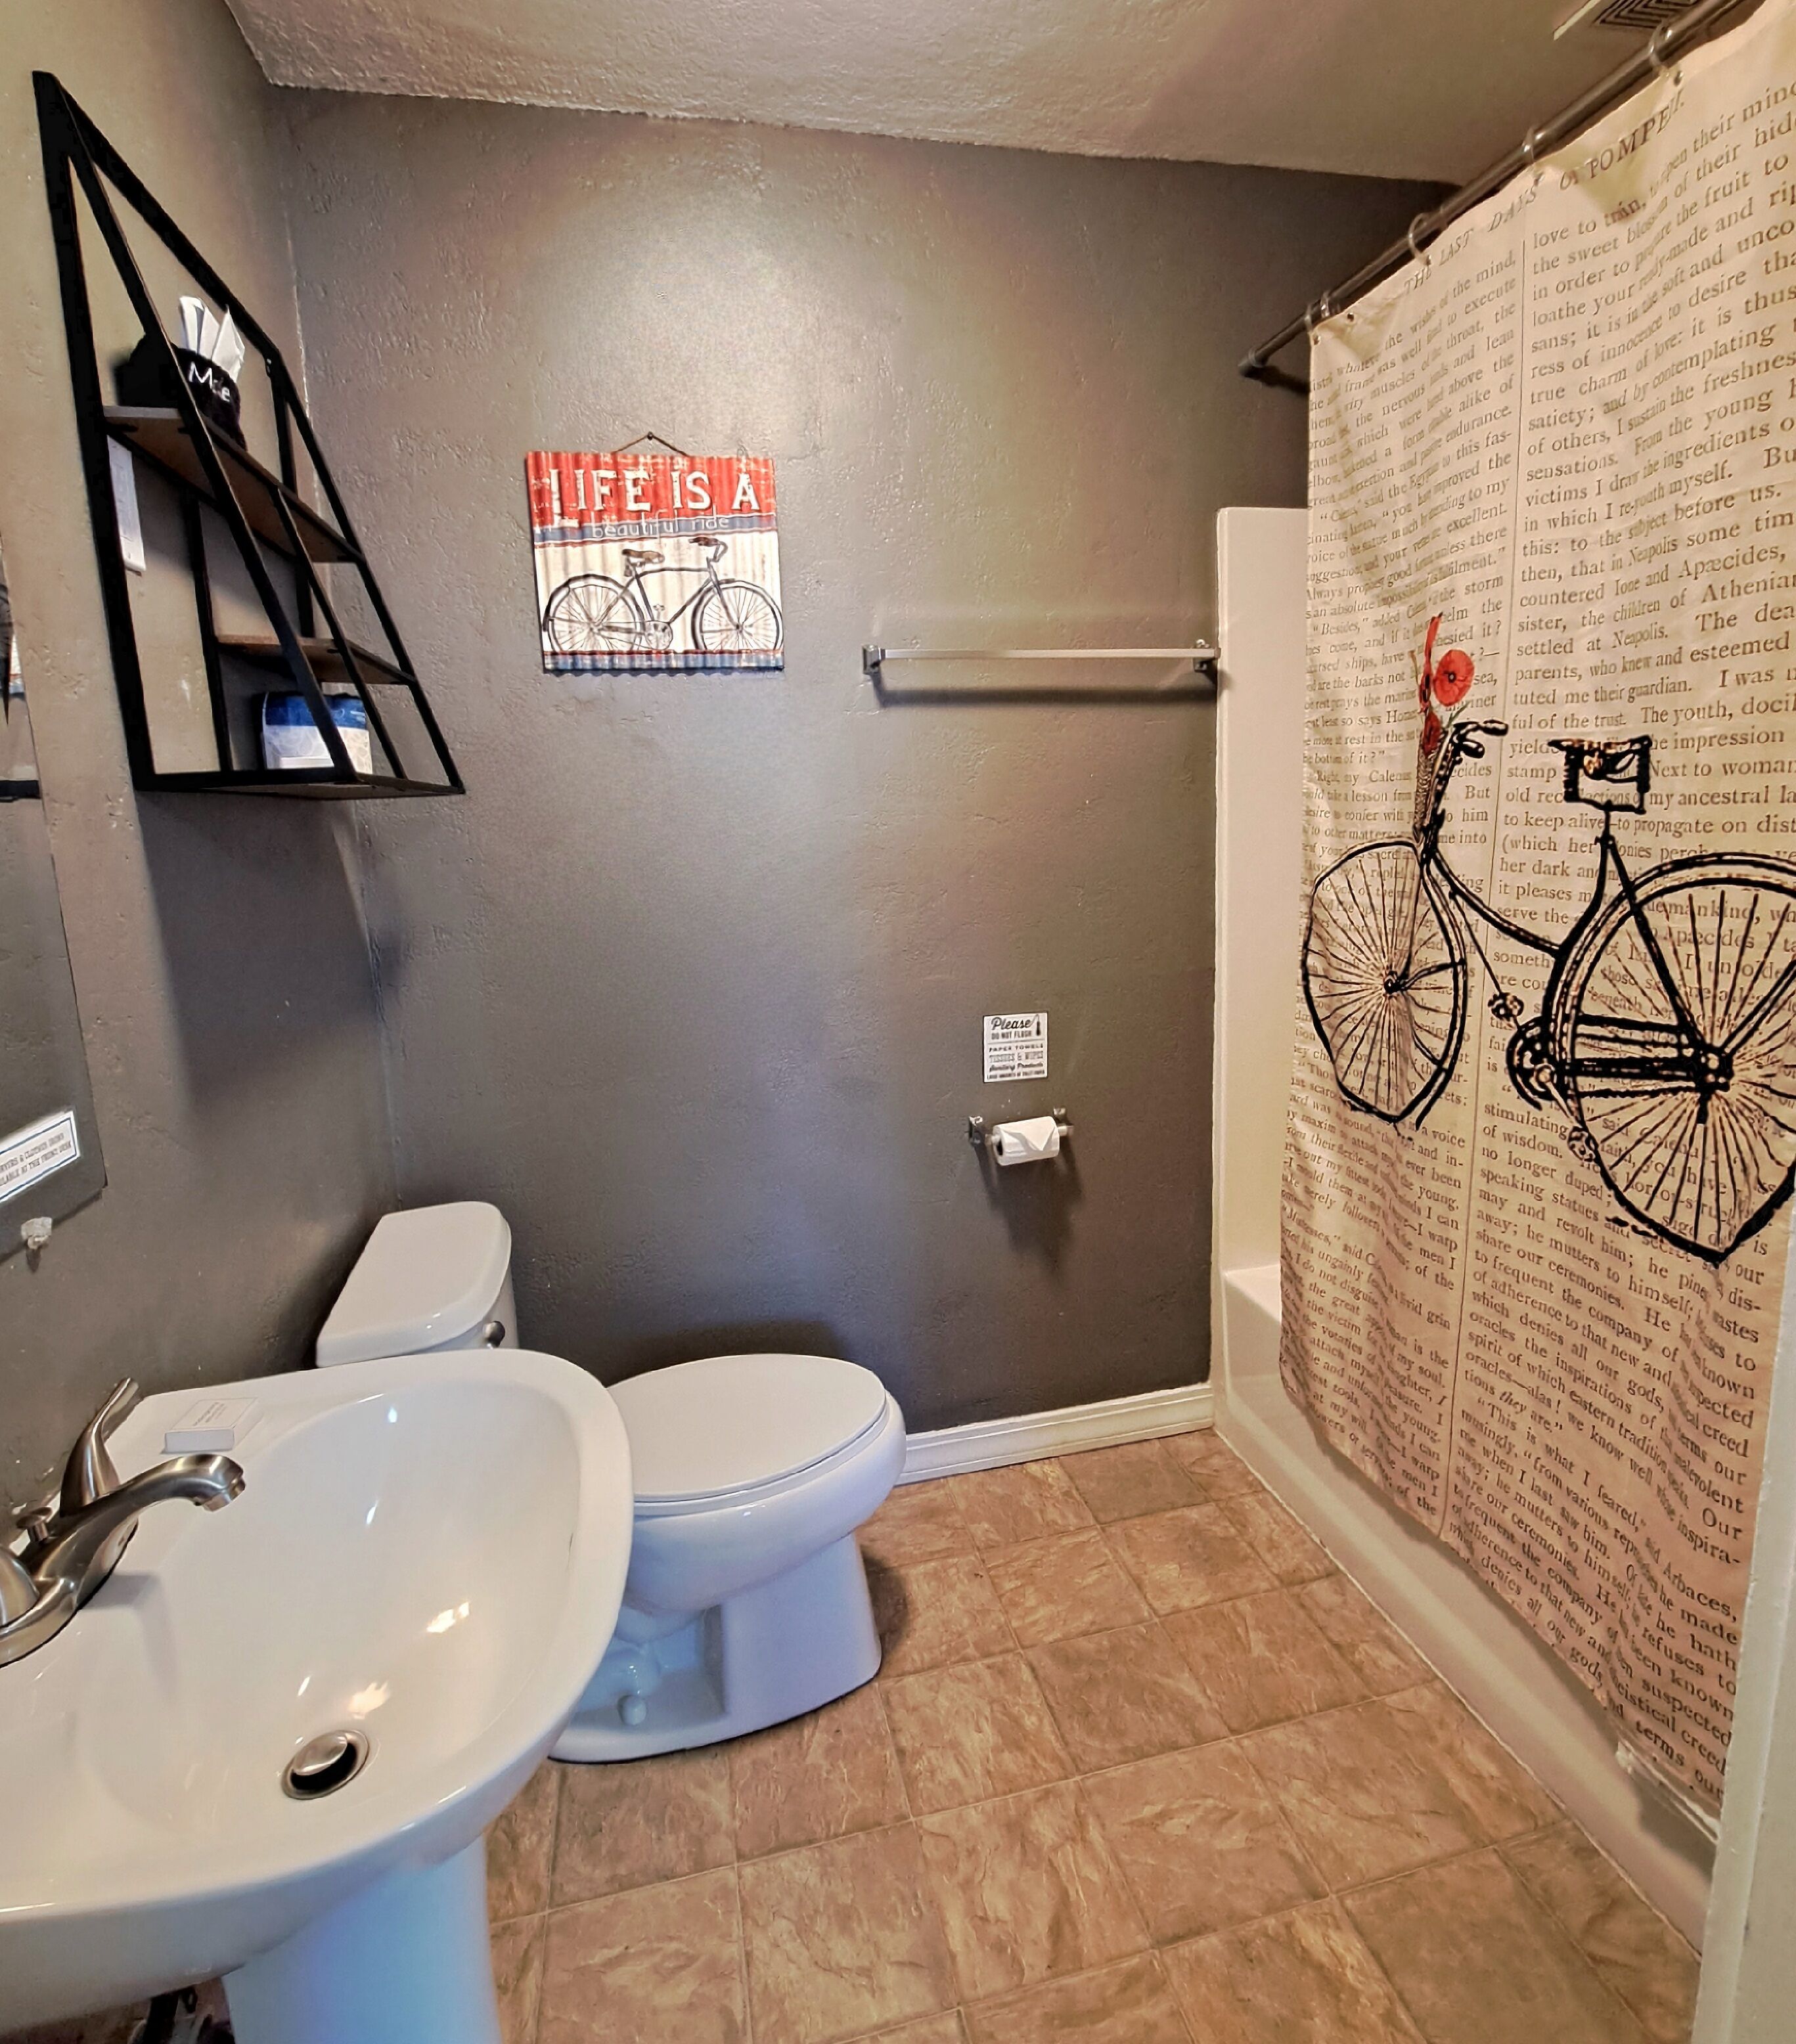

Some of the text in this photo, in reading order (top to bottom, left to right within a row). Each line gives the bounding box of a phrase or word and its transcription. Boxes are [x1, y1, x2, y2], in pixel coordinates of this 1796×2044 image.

[1534, 114, 1734, 250] love to their
[1534, 141, 1740, 275] the sweet their
[1534, 154, 1788, 301] in order to fruit to
[1440, 229, 1471, 267] LAST
[1534, 202, 1753, 326] loathe your and
[1465, 277, 1516, 314] execute
[1531, 244, 1722, 353] sans; and
[1531, 270, 1747, 380] ress of desire
[1531, 285, 1796, 405] true charm it is thus
[1528, 322, 1776, 432] satiety; and contemplating
[1526, 388, 1773, 481] sensations. From the young
[1527, 384, 1694, 456] of others, the
[1525, 420, 1770, 507] victims ingredients
[549, 468, 760, 528] LIFE IS A
[1522, 484, 1782, 558] this: to the before us.
[1525, 460, 1733, 533] in which myself.
[591, 504, 729, 545] beautiful ride
[1470, 527, 1507, 546] there
[1521, 523, 1740, 583] then, that some
[1465, 578, 1504, 596] storm
[1518, 588, 1688, 633] sister, the children of
[1519, 582, 1604, 608] countered
[1645, 563, 1669, 587] and
[1515, 631, 1790, 686] parents, who and esteemed
[1517, 611, 1738, 657] settled at Neapolis. The
[1513, 668, 1774, 706] tuted me their guardian. was
[1540, 700, 1734, 729] of the The youth,
[1673, 725, 1785, 750] impression
[1507, 760, 1712, 784] stamp to
[1506, 785, 1770, 811] old my ancestral
[1502, 834, 1558, 854] (which
[1504, 812, 1748, 838] to keep propagate on
[1516, 880, 1573, 902] pleases
[1532, 858, 1570, 877] dark
[1544, 907, 1569, 924] the
[991, 1016, 1033, 1031] Please
[1431, 1129, 1466, 1149] voice
[1485, 1103, 1569, 1141] stimulating
[1502, 1130, 1563, 1159] wisdom.
[1508, 1150, 1557, 1178] longer
[1479, 1188, 1594, 1245] may and revolt
[1480, 1166, 1599, 1222] speaking statues
[1428, 1230, 1458, 1252] warp
[1477, 1209, 1600, 1272] away; mutters
[1475, 1228, 1672, 1332] share ceremonies. He
[1493, 1255, 1653, 1352] frequent the company
[1491, 1280, 1673, 1387] adherence that new and
[1469, 1311, 1632, 1414] oracles the inspirations
[1471, 1291, 1749, 1458] which denies our creed
[1468, 1330, 1743, 1541] spirit which eastern Our
[1590, 1425, 1625, 1461] know
[1663, 1561, 1737, 1624] Arbaces,
[1642, 1626, 1705, 1676] refuses
[1680, 1608, 1738, 1645] made
